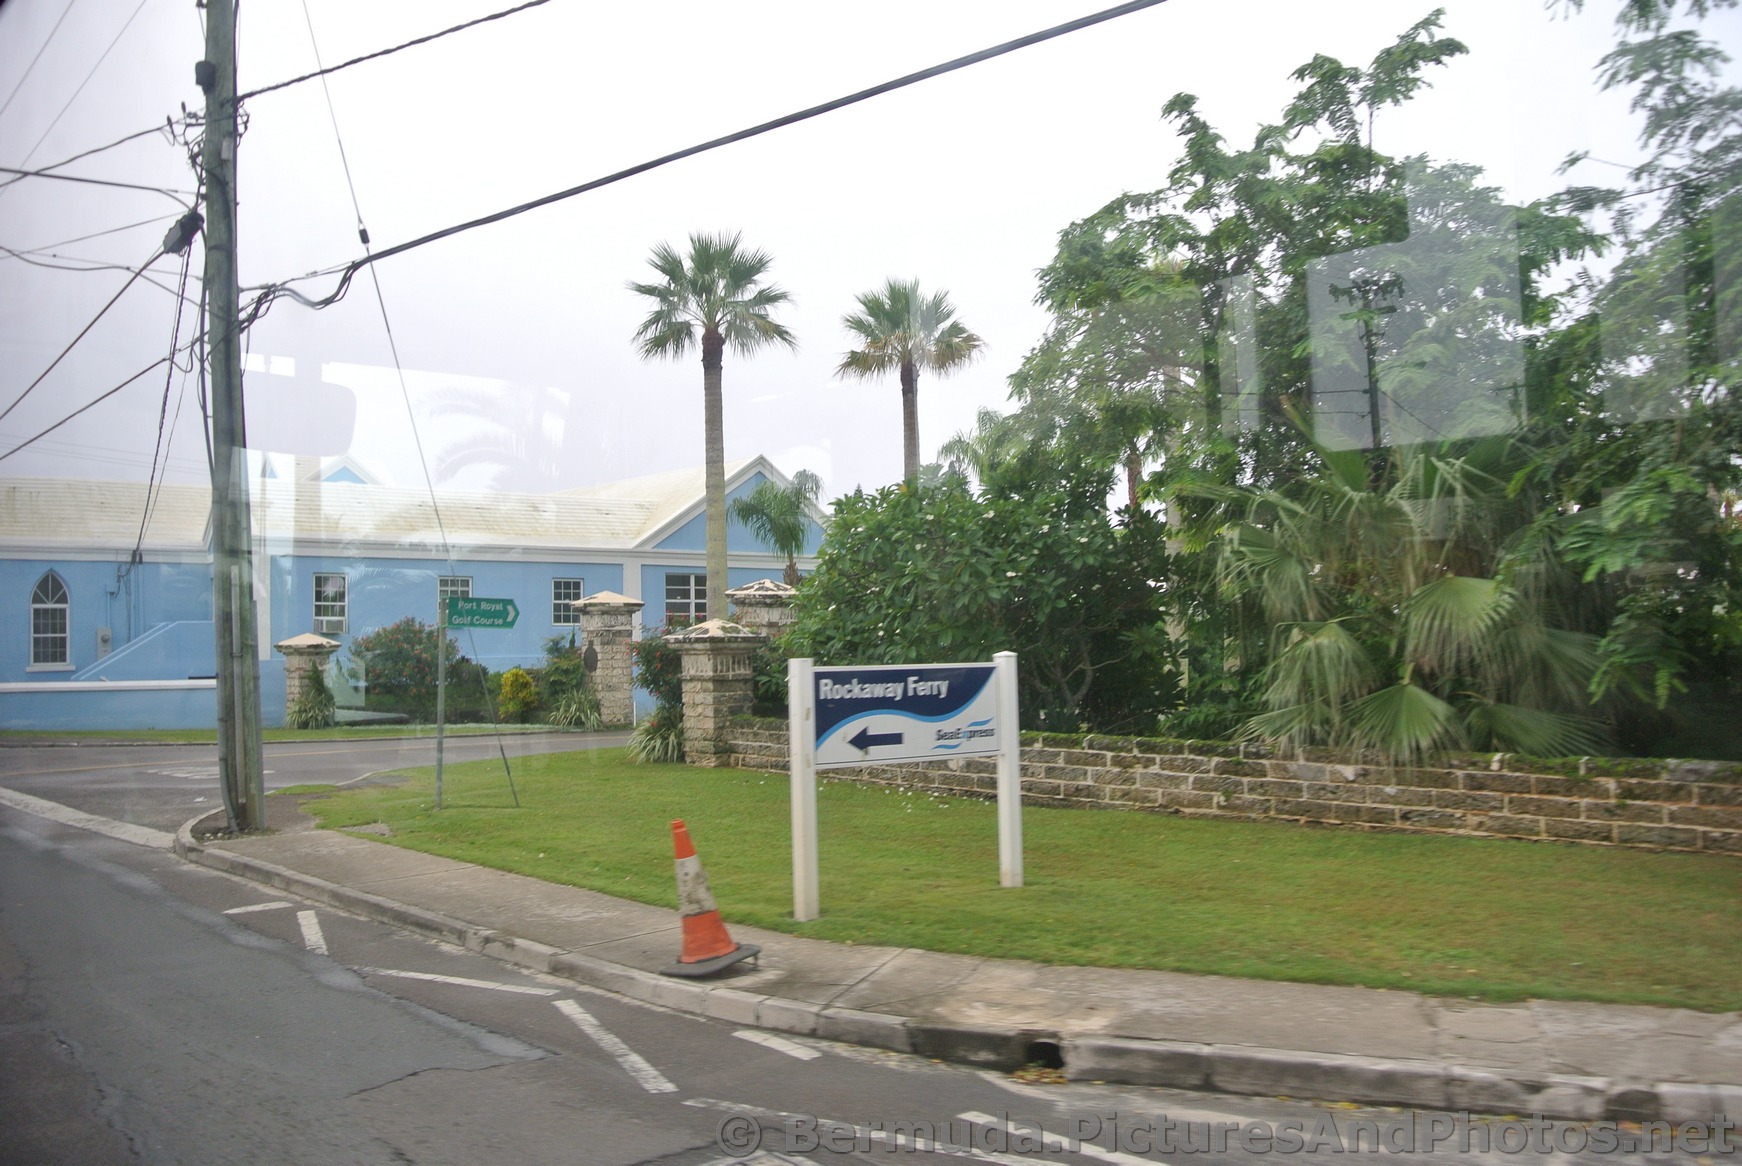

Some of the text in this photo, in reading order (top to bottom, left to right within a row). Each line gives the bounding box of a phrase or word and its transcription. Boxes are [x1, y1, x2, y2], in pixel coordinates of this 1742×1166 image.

[458, 600, 504, 611] Port Royal
[452, 615, 504, 625] Golf Course
[819, 676, 949, 702] Rockaway Ferry
